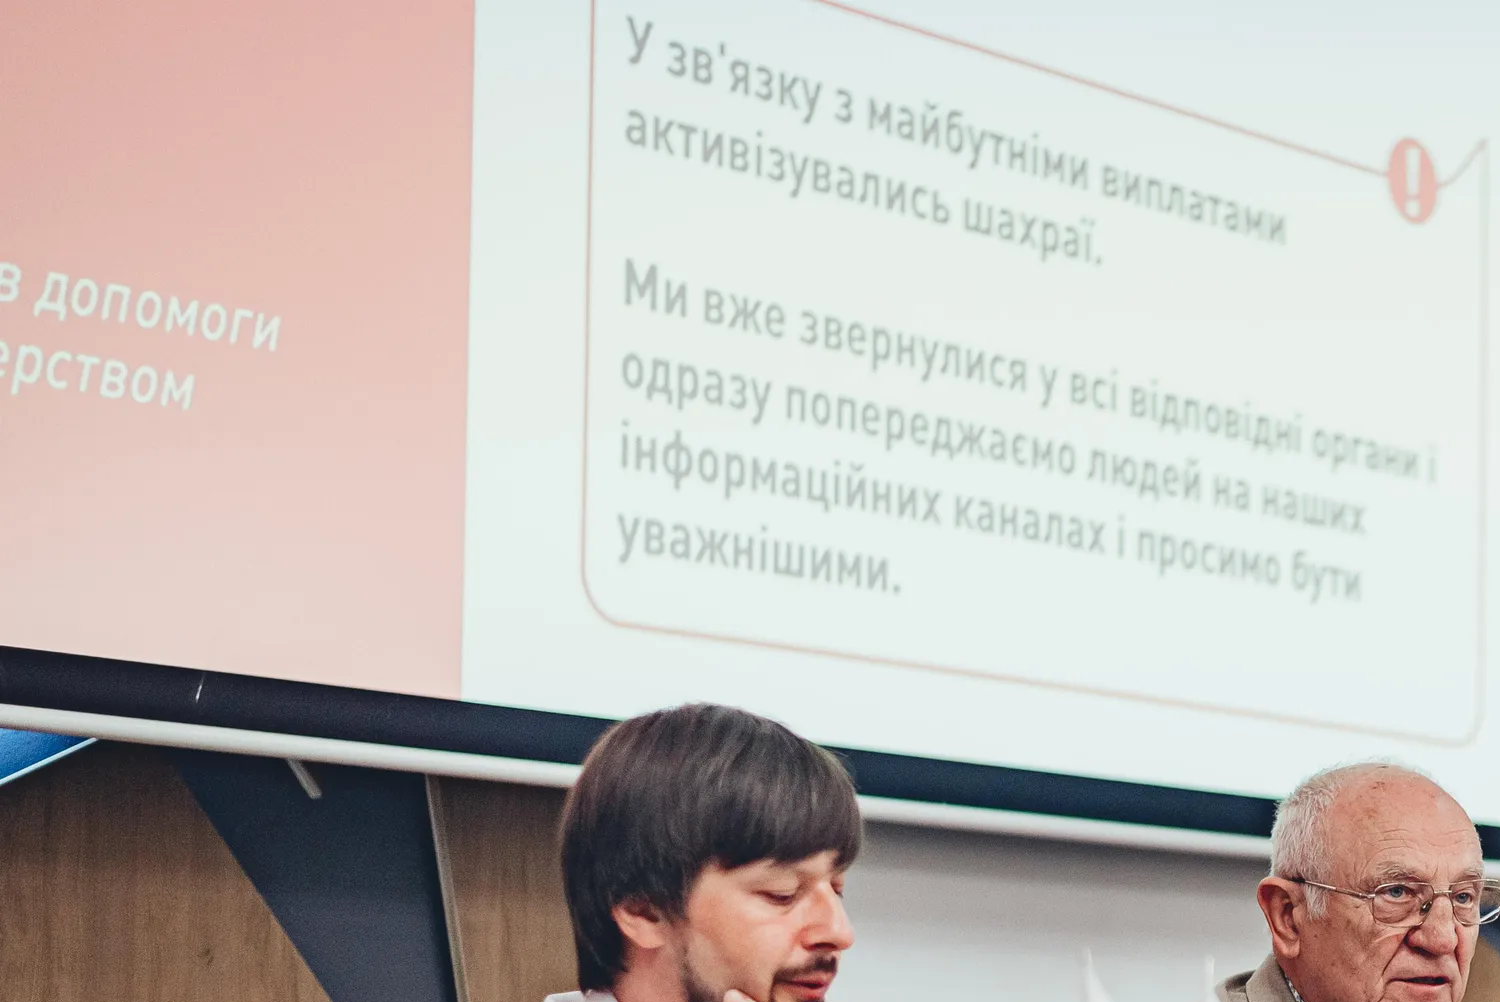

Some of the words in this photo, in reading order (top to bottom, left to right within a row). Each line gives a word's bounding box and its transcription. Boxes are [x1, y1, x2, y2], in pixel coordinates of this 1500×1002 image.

[625, 109, 950, 225] активізувались
[963, 196, 1102, 266] шахраї.
[626, 14, 652, 65] У
[667, 41, 822, 124] зв'язку
[835, 88, 852, 124] з
[867, 98, 1089, 192] майбутніми
[1100, 164, 1287, 246] виплатами
[34, 271, 281, 352] допомоги
[624, 258, 688, 318] Ми
[704, 289, 785, 338] вже
[799, 311, 1027, 393] звернулися
[1040, 364, 1058, 408] у
[1070, 368, 1118, 412] всі
[1130, 378, 1302, 453] відповідні
[1312, 427, 1419, 478] органи
[620, 420, 942, 525] інформаційних
[953, 495, 1106, 555] каналах
[1117, 514, 1126, 558] і
[1137, 528, 1280, 587] просимо
[1291, 550, 1362, 605] бути
[622, 352, 771, 425] одразу
[786, 385, 1075, 475] попереджаємо
[1086, 448, 1202, 501] людей
[1213, 472, 1250, 512] на
[1262, 485, 1366, 535] наших
[617, 512, 902, 594] уважнішими.
